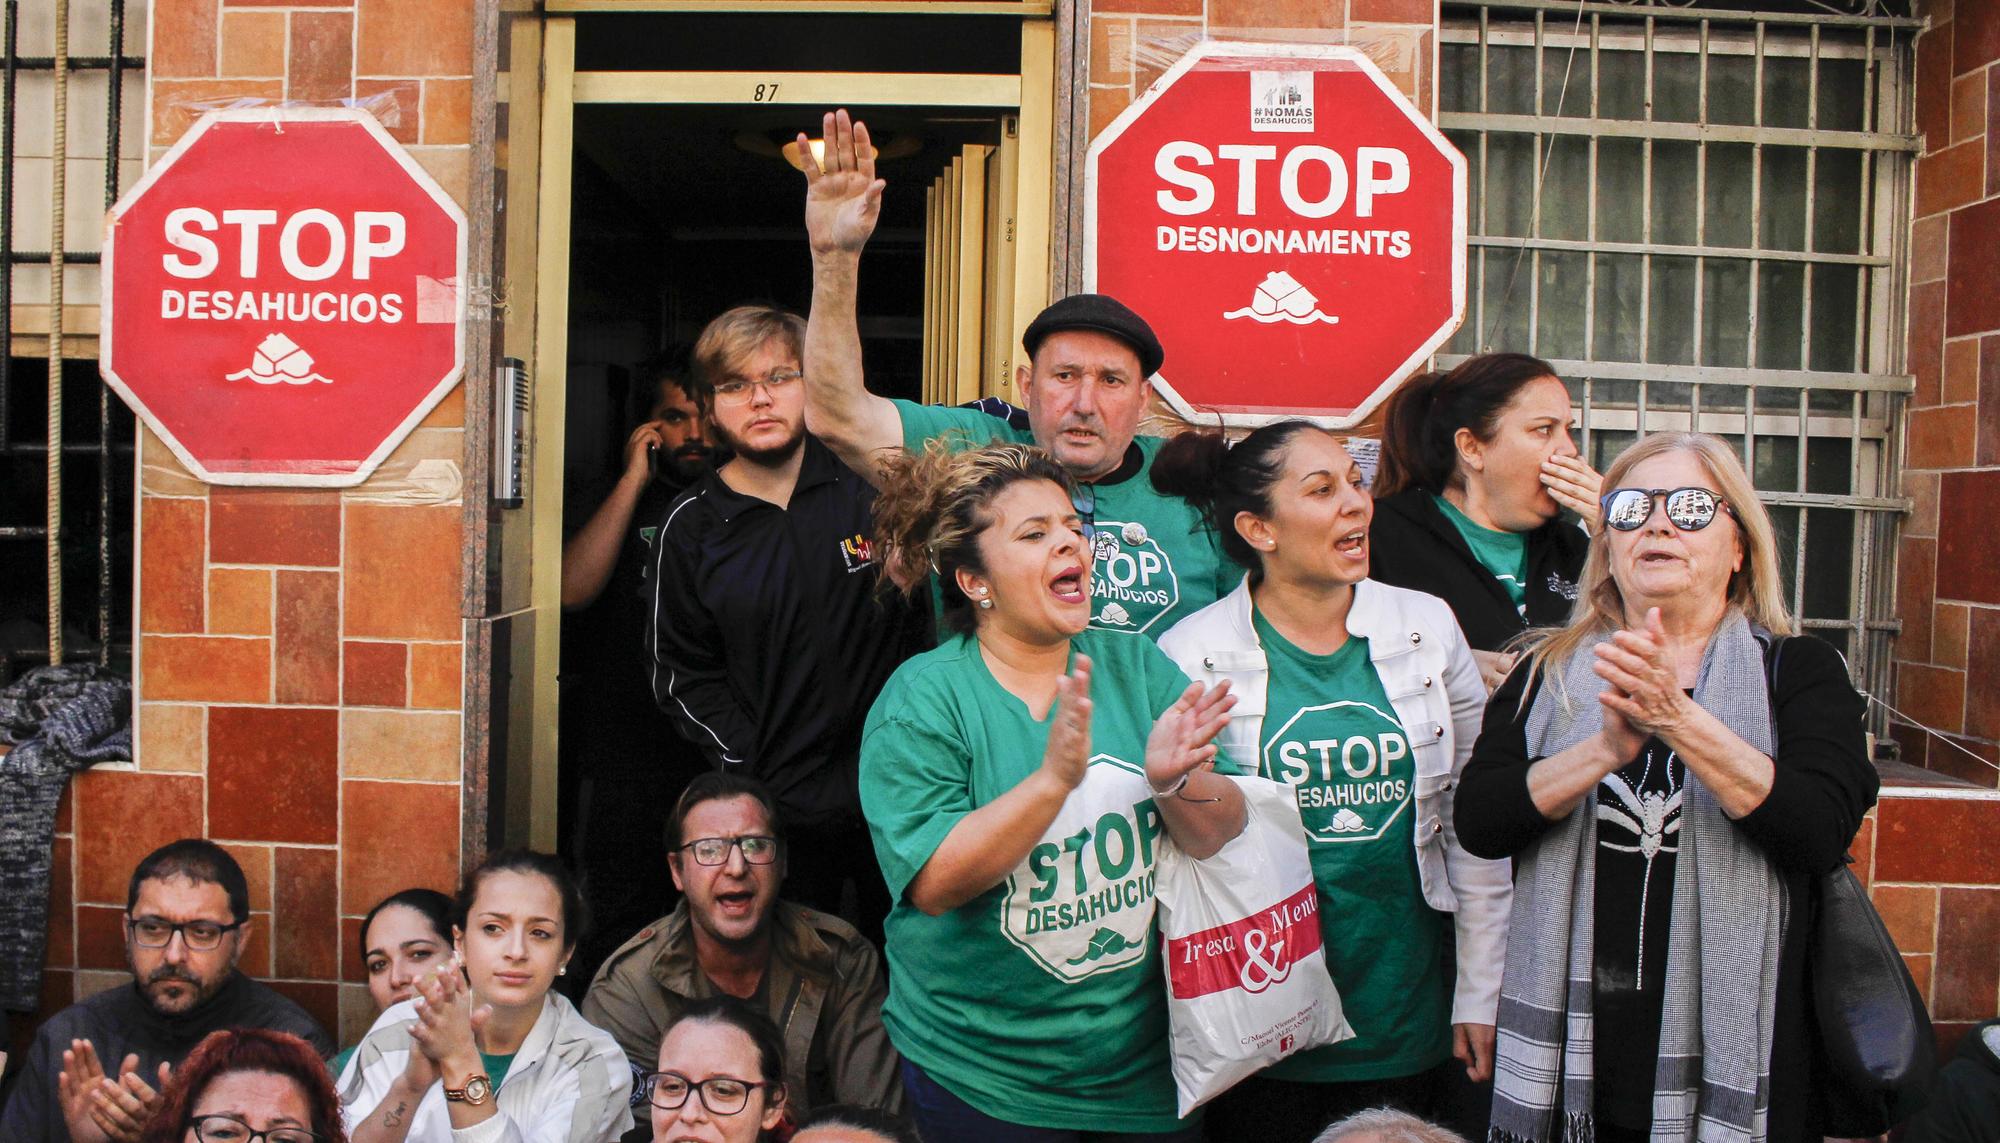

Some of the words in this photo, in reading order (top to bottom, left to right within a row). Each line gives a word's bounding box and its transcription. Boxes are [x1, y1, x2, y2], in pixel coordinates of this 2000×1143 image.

[753, 83, 780, 103] 87
[1254, 117, 1313, 125] DESAHUCIOS
[1154, 140, 1411, 218] STOP
[162, 207, 407, 281] STOP
[1157, 226, 1411, 258] DESNONAMENTS
[161, 289, 403, 323] DESAHUCIOS
[1090, 577, 1168, 606] SAHUCIOS
[1279, 732, 1407, 785] STOP
[1297, 778, 1406, 809] ESAHUCIOS
[1028, 798, 1163, 903] STOP
[1026, 869, 1156, 935] DESAHUCIO
[1240, 929, 1292, 993] &
